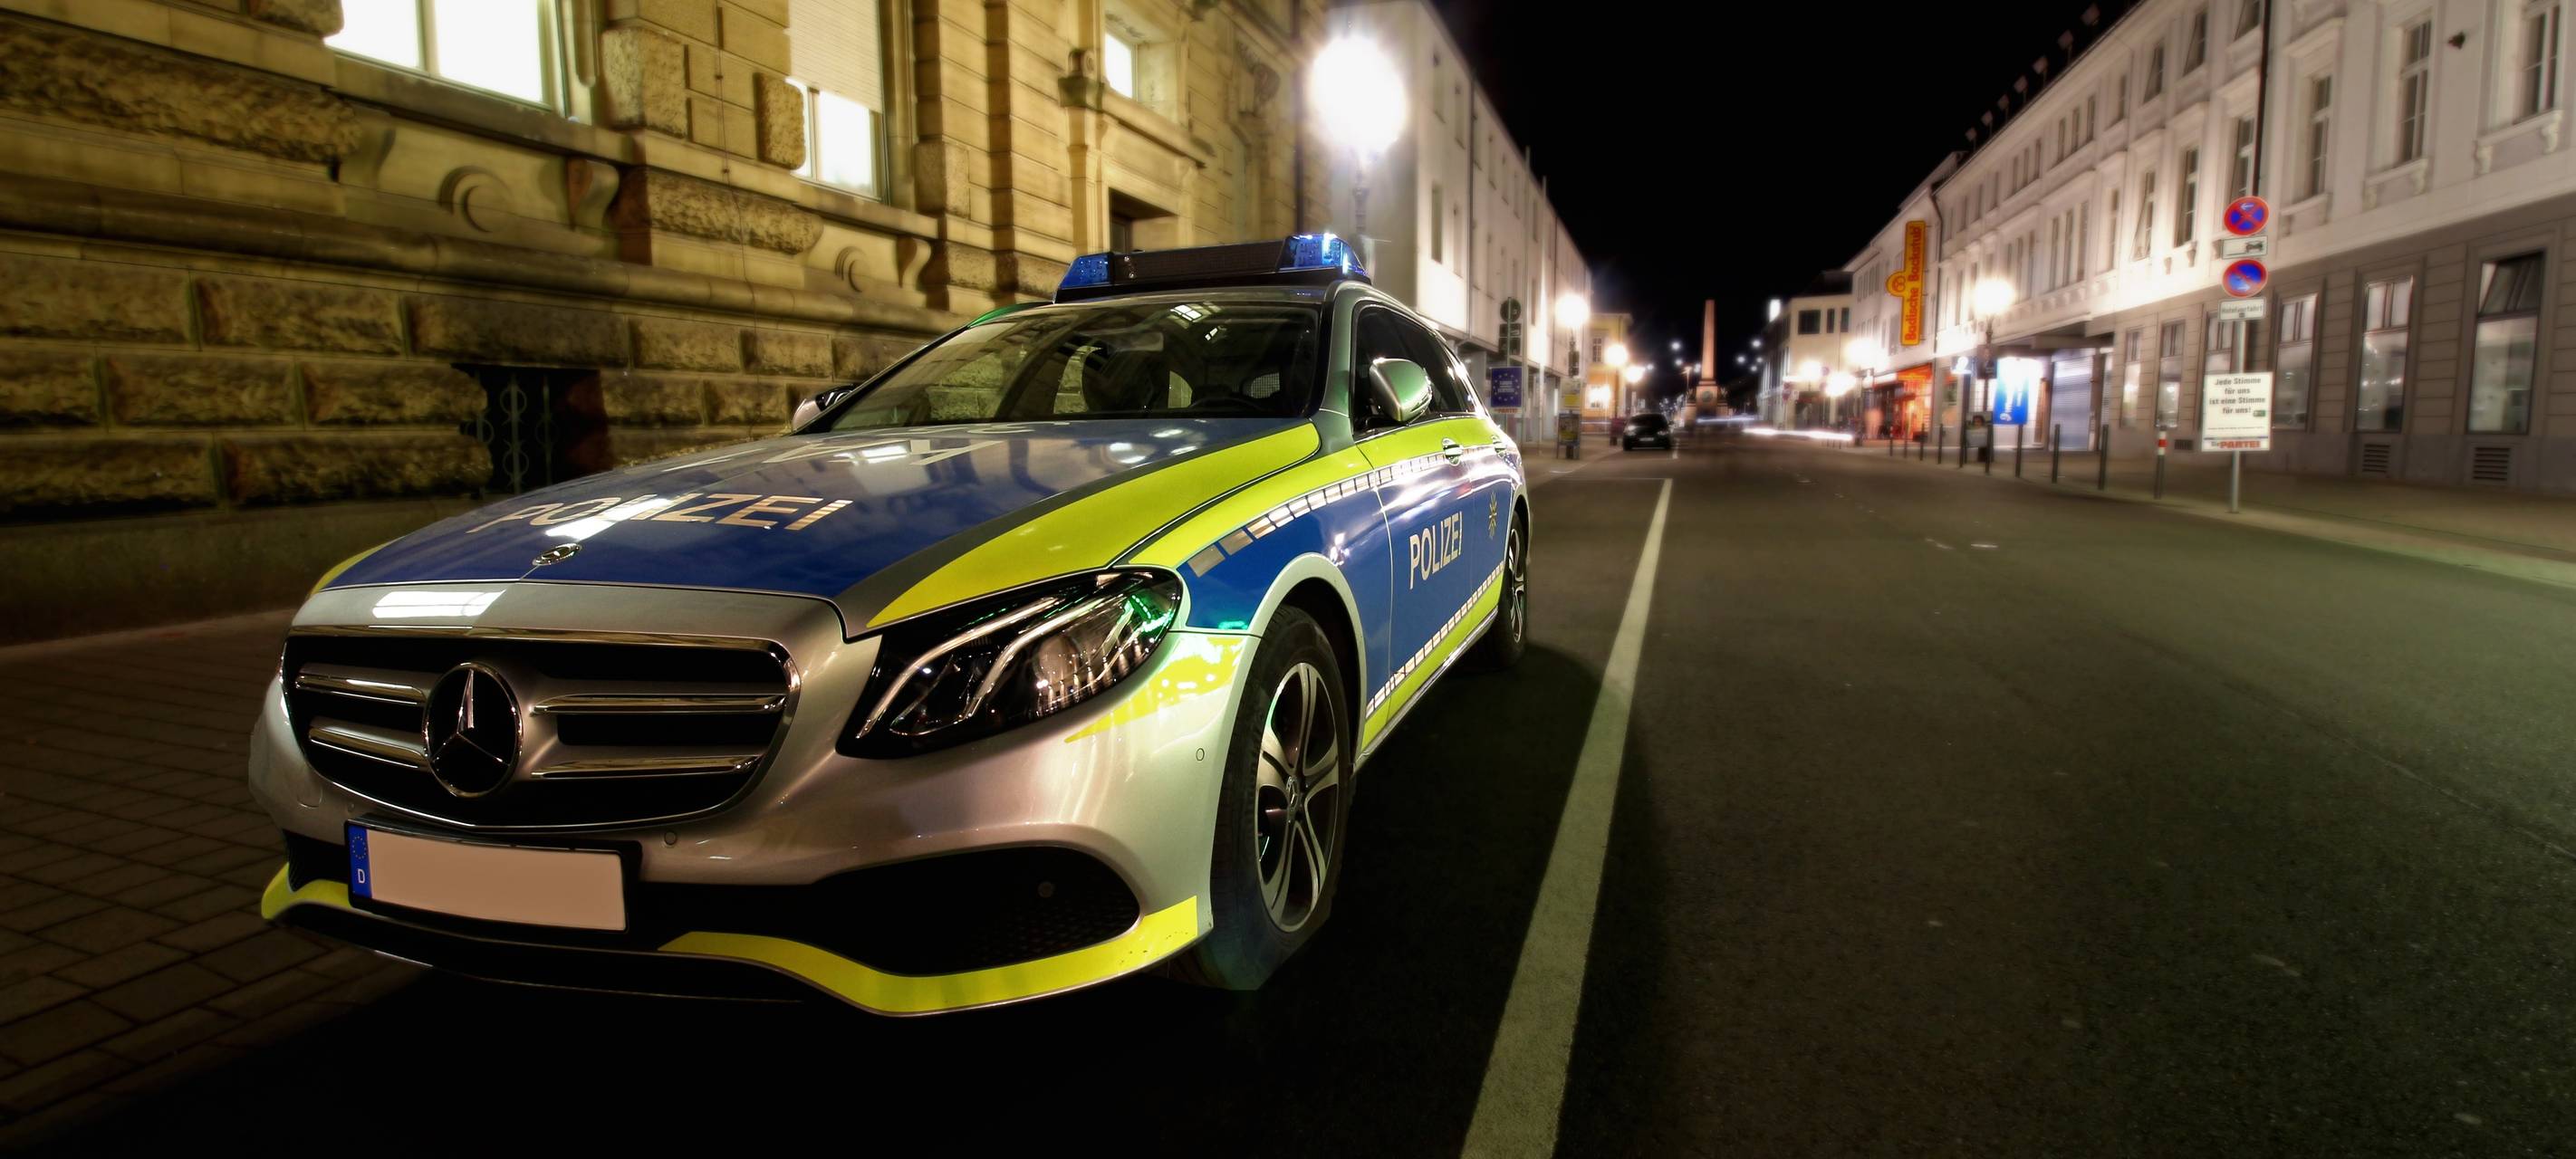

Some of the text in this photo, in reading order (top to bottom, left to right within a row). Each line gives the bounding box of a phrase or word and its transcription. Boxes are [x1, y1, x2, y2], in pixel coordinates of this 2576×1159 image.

[1905, 288, 1918, 340] Badische
[2234, 377, 2262, 385] Stimme
[2220, 440, 2261, 449] PARTEI
[1409, 511, 1463, 589] POLIZEI
[358, 868, 365, 884] D
